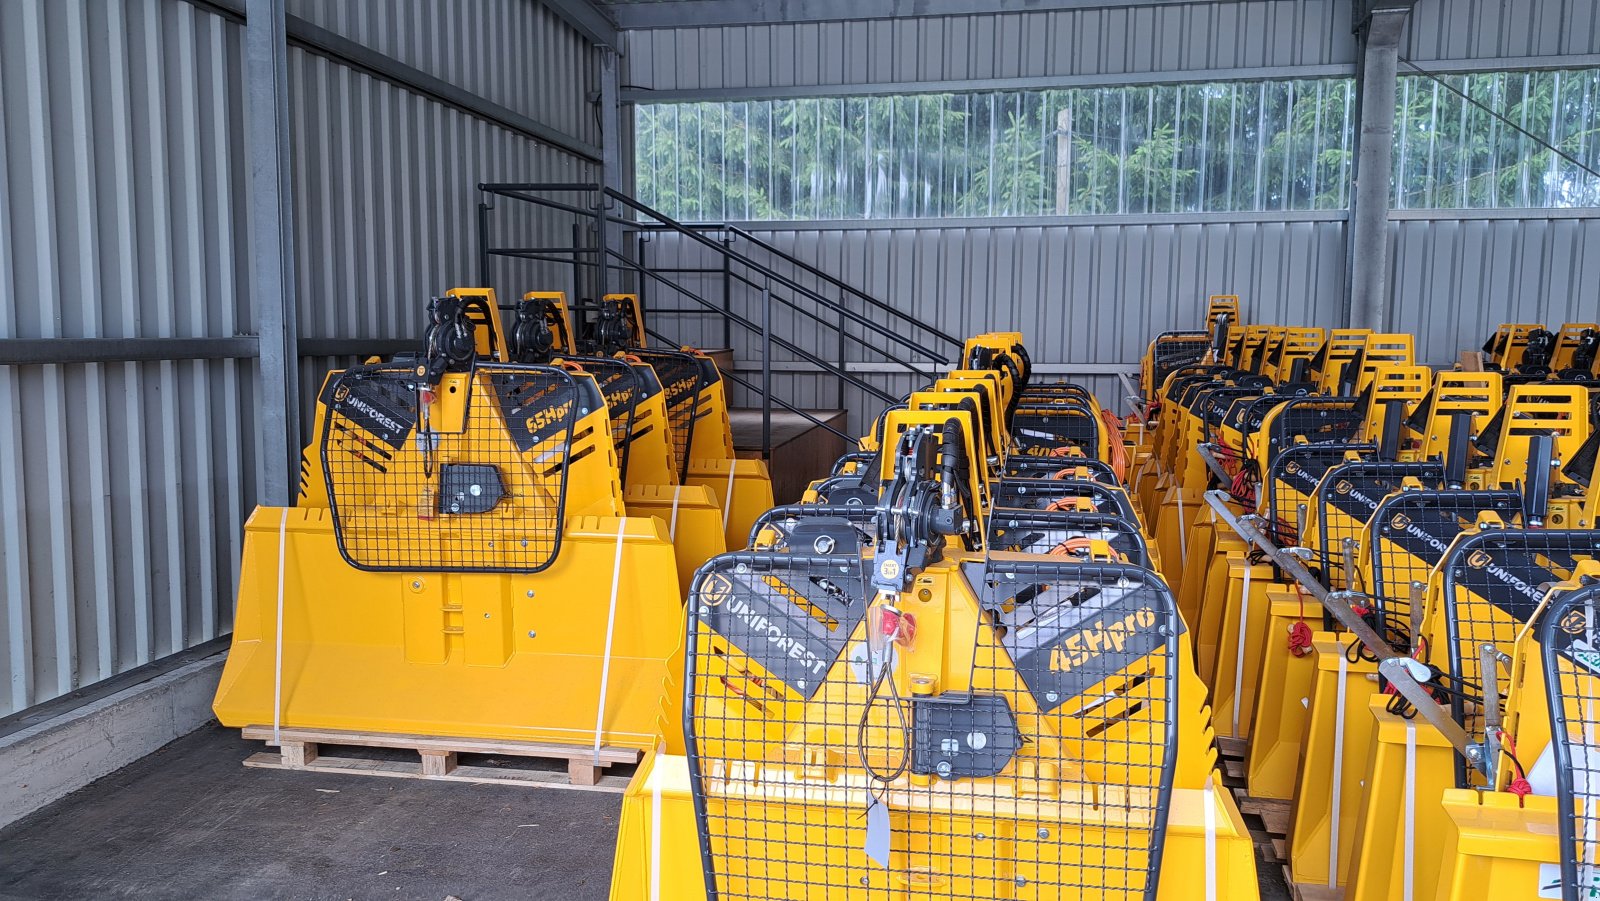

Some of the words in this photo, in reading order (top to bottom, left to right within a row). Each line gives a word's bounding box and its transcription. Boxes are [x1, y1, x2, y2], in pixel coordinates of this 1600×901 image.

[664, 374, 698, 400] 85Hpr
[346, 394, 404, 434] UNIFOREST
[525, 399, 573, 434] 65Hpr
[726, 595, 826, 675] UNIFOREST
[1049, 606, 1156, 675] 45Hpro
